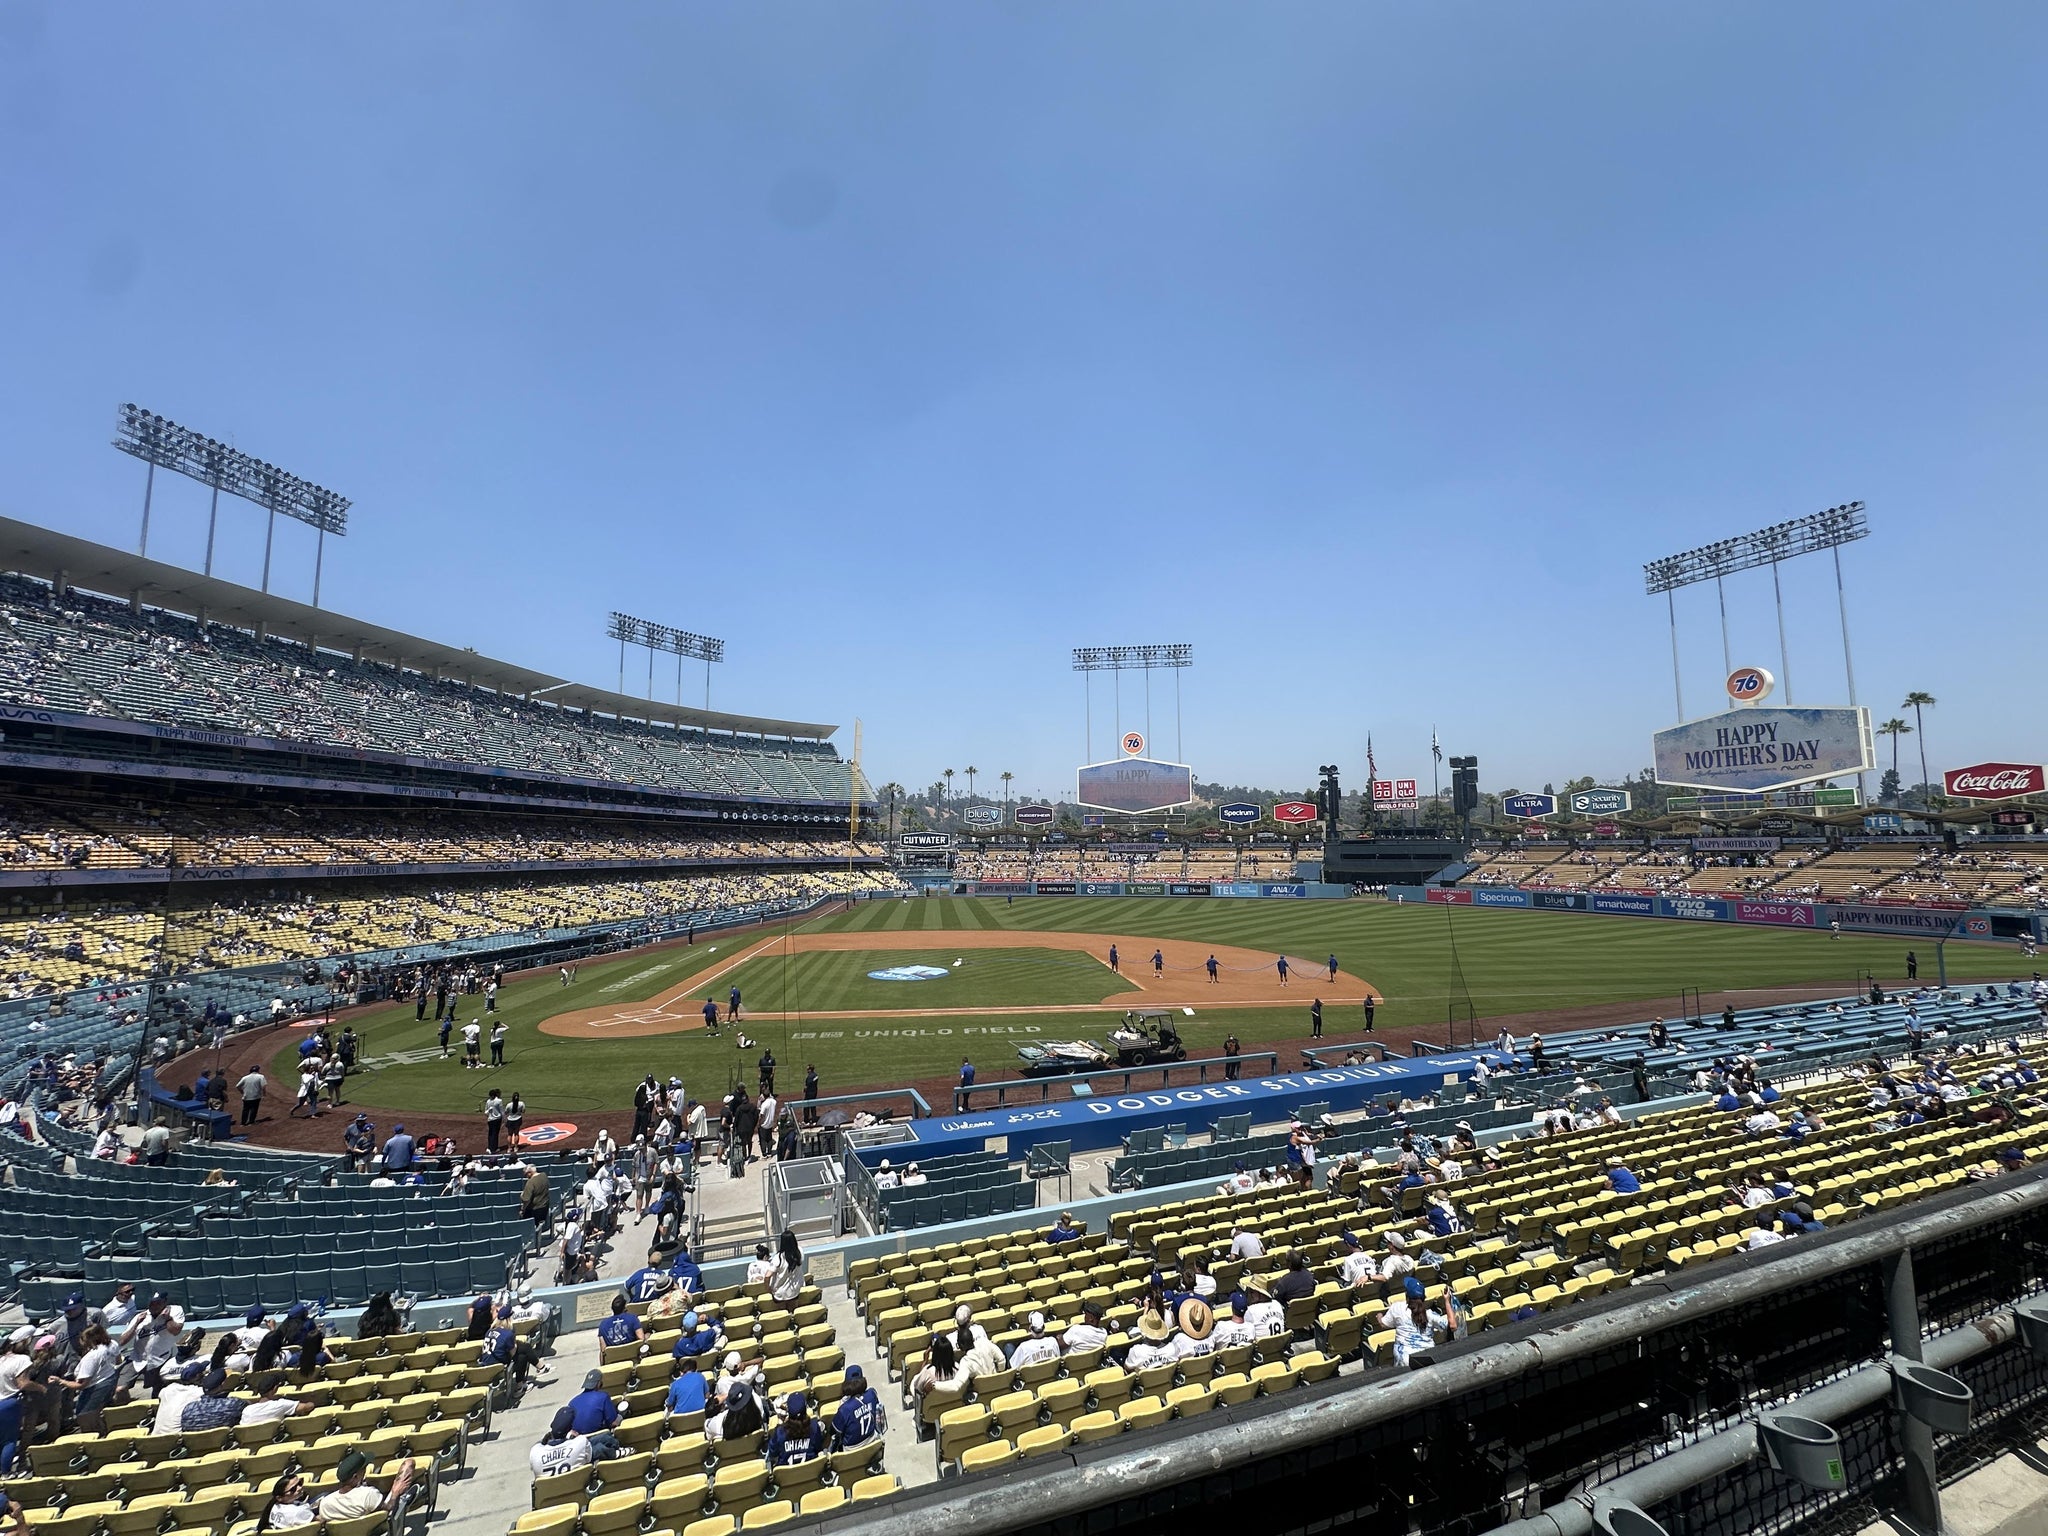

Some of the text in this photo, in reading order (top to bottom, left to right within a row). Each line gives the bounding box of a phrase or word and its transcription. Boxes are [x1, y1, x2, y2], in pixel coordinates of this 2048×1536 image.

[1734, 674, 1759, 693] 76
[0, 707, 53, 723] una
[156, 726, 249, 747] HAPPY MOTHER'S DAY
[1716, 722, 1779, 748] HAPPY
[1127, 738, 1140, 748] 76
[322, 750, 353, 758] AMERICA
[1685, 739, 1820, 770] MOTHER'S DAY
[1780, 763, 1813, 771] nuna
[1115, 769, 1151, 783] HAPPY
[1953, 768, 2034, 792] Coca-Cola
[1591, 794, 1621, 803] Security
[968, 810, 989, 818] blue
[1223, 809, 1254, 817] Spectrum
[1868, 816, 1898, 827] TEL
[903, 836, 946, 844] CUTWATER
[1699, 839, 1774, 849] HAPPY MOTHER'S DAY
[128, 872, 162, 880] Presented
[181, 869, 234, 879] nuna
[327, 866, 349, 876] HAPPY
[1216, 886, 1236, 895] TEL
[1480, 892, 1522, 903] Spectrum
[1544, 895, 1566, 905] blue
[1596, 899, 1650, 911] smartwater
[1670, 900, 1705, 909] TOYO
[1743, 905, 1788, 915] DAISO
[1676, 907, 1716, 918] TIRES
[1836, 911, 1960, 929] HAPPY MOTHER'S DAY
[1970, 920, 1987, 931] 76
[855, 1025, 1042, 1037] UNIQLO FIELD
[1087, 1064, 1410, 1114] DODGER STADIUM
[941, 1119, 995, 1132] Welcome
[1449, 1217, 1460, 1233] 17
[640, 1280, 657, 1299] 17
[678, 1276, 692, 1293] 17
[1268, 1322, 1281, 1336] 18
[1231, 1333, 1248, 1342] BETTS
[854, 1402, 873, 1419] OHTANI
[860, 1413, 873, 1436] 17
[784, 1438, 811, 1452] OHTANI
[541, 1447, 574, 1465] CHAVEZ
[787, 1452, 807, 1466] 17
